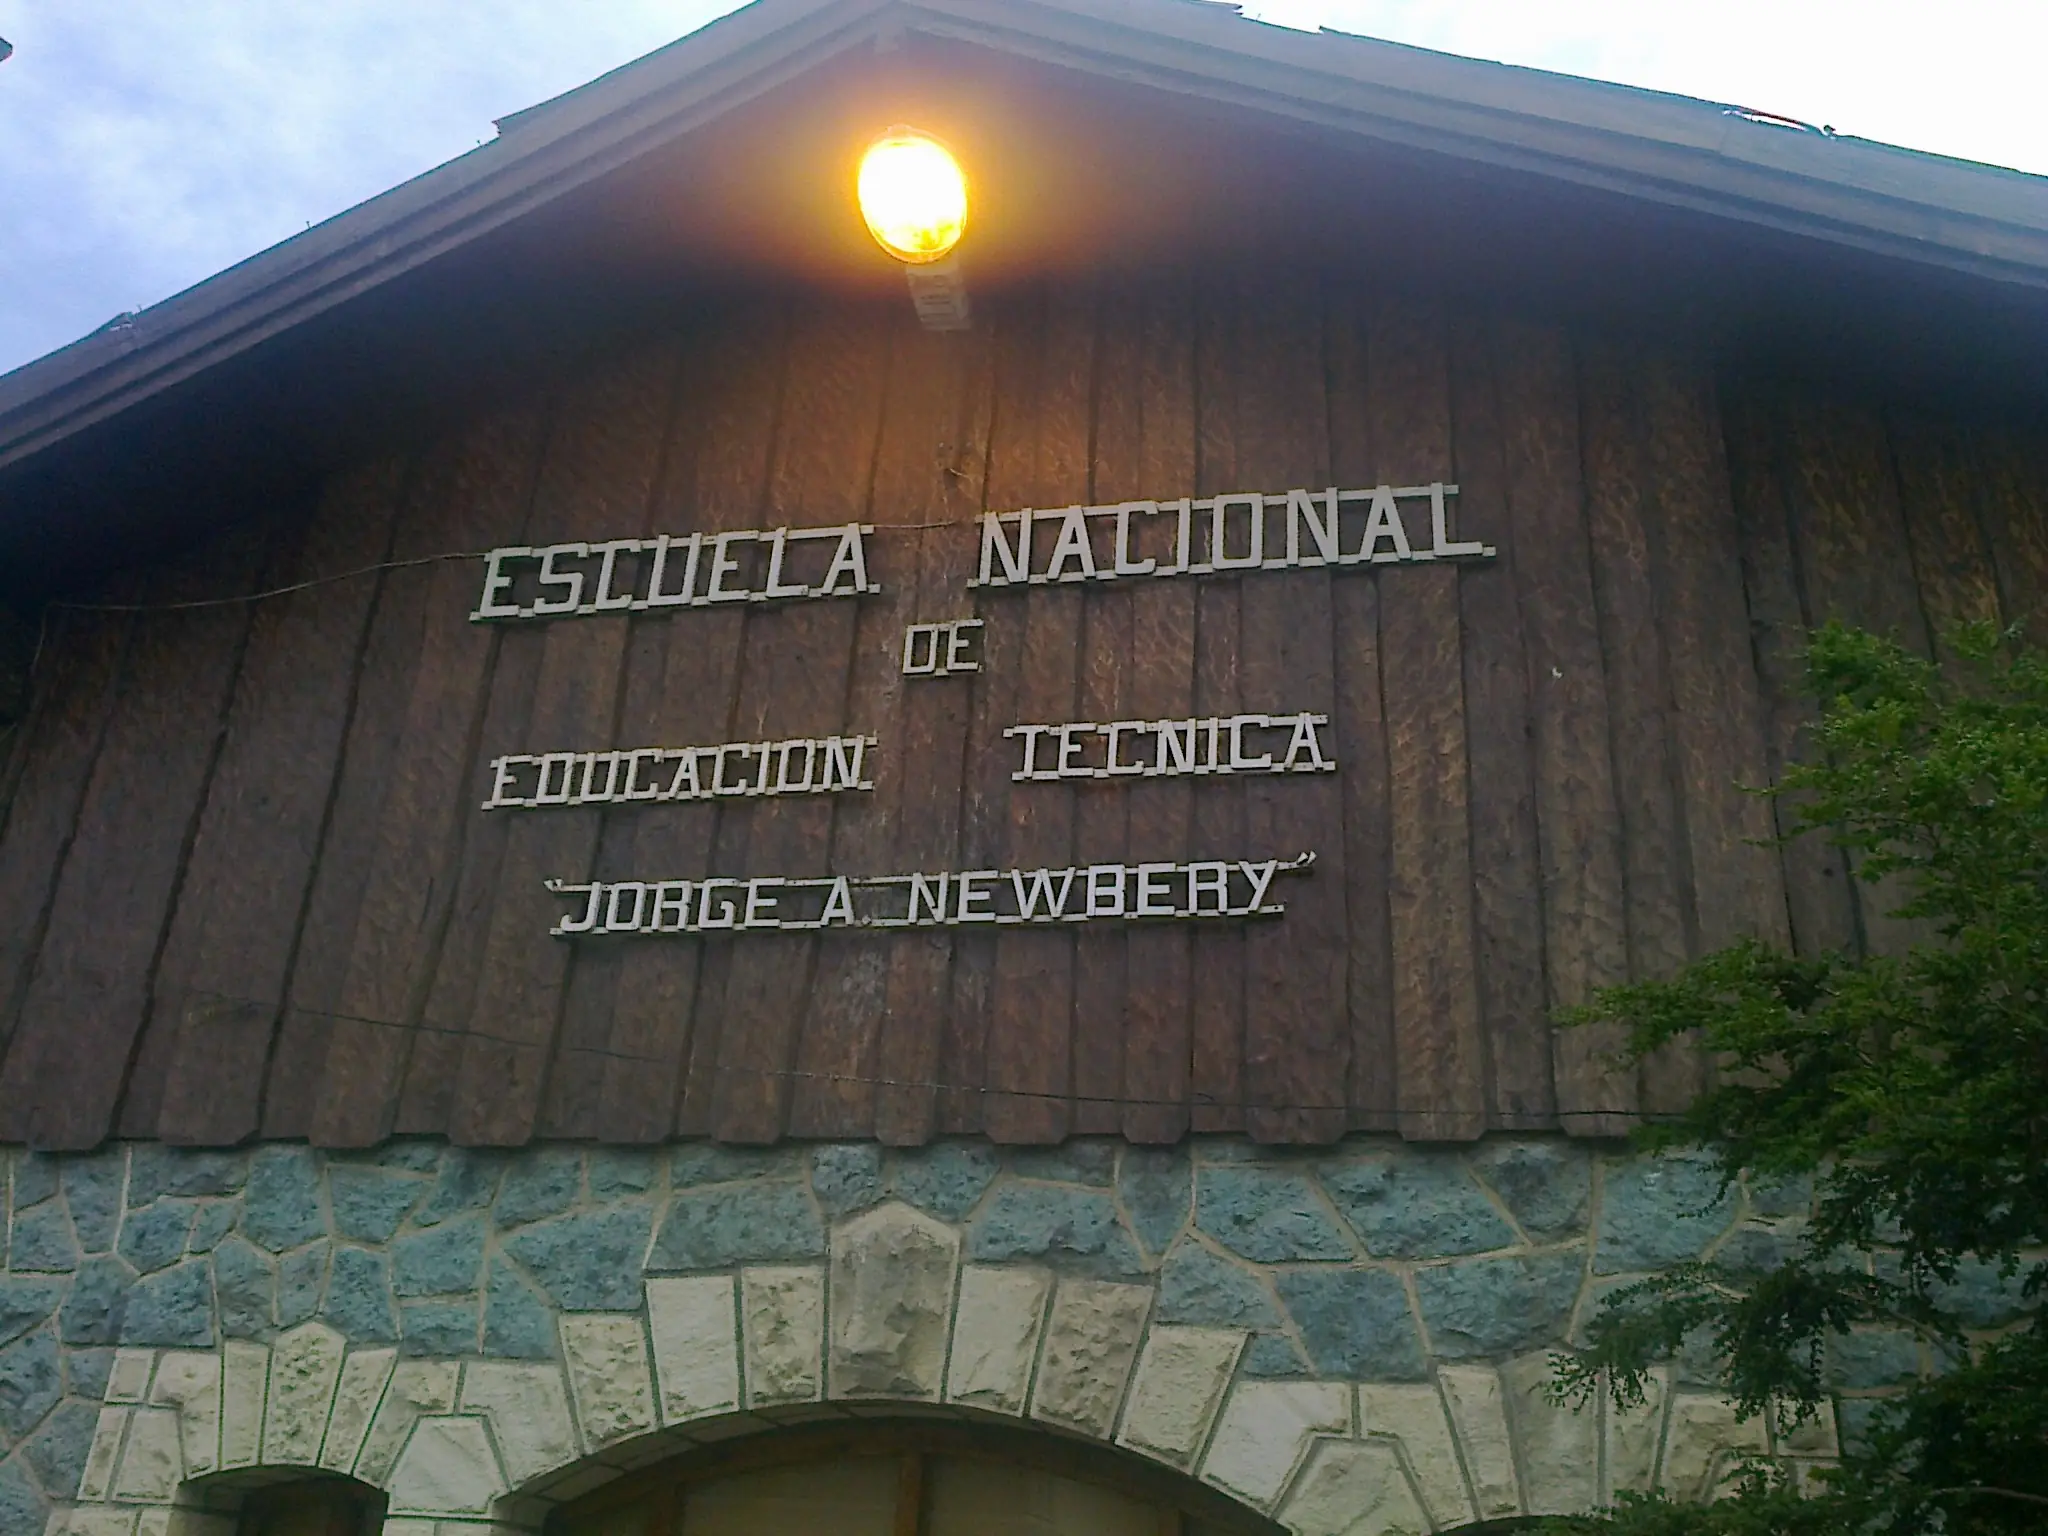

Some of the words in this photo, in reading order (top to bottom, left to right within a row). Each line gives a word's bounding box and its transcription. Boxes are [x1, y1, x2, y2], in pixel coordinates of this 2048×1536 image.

[476, 522, 872, 619] ESCUELA
[977, 482, 1486, 586] NACIONAL
[902, 619, 985, 675] DE
[490, 734, 868, 808] EDUCACION
[1006, 711, 1328, 779] TECNICA
